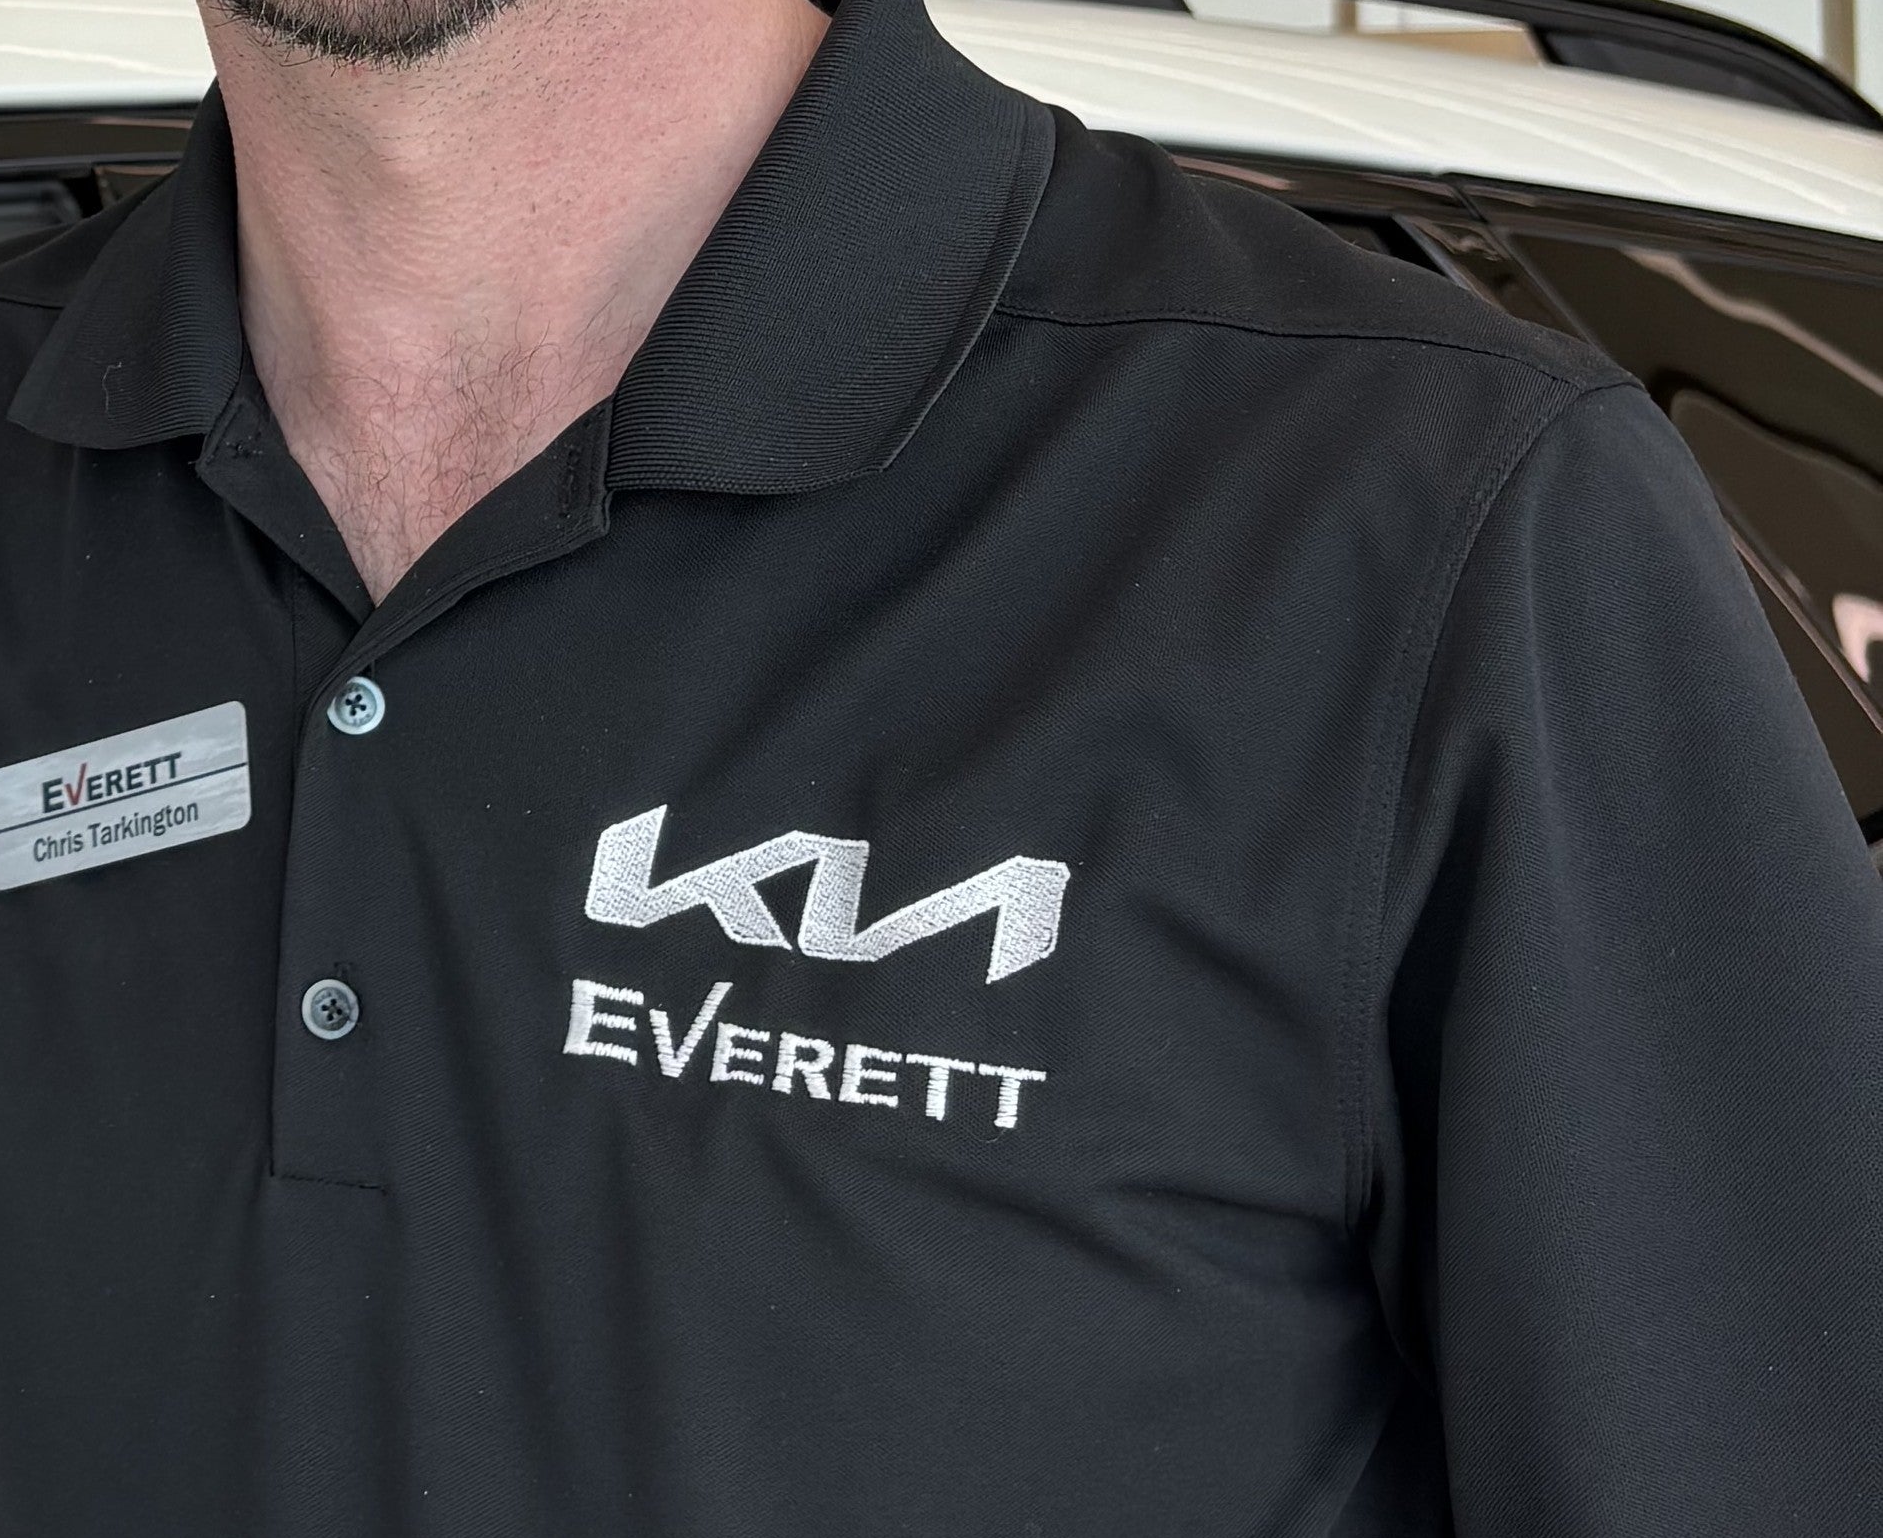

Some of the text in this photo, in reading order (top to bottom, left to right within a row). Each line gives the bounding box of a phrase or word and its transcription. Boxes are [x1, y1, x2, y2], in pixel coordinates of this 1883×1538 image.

[33, 802, 200, 862] Chris Tarkington
[42, 752, 182, 814] EVERETT
[585, 804, 1071, 984] KIA
[563, 978, 1047, 1128] EVERETT
